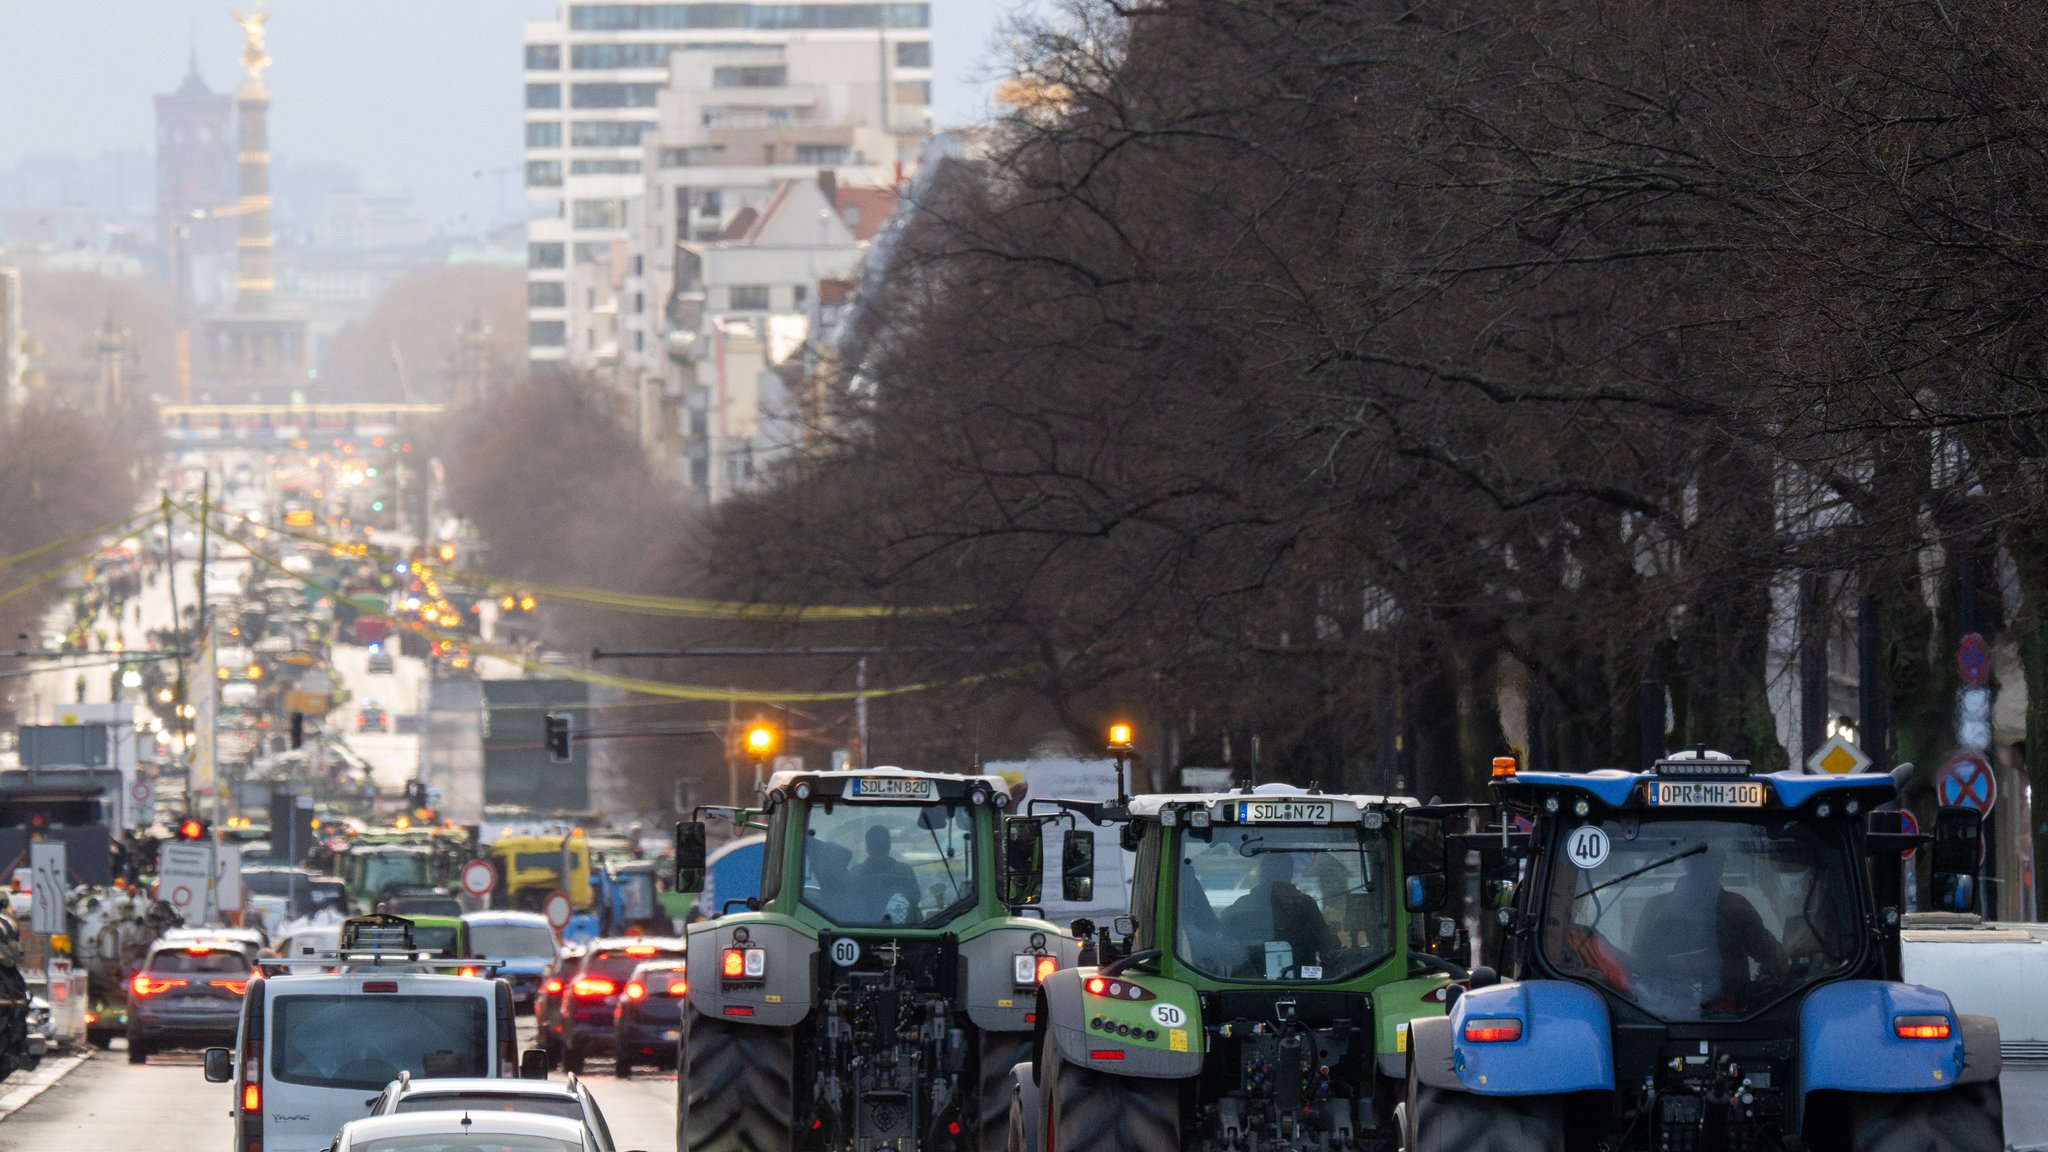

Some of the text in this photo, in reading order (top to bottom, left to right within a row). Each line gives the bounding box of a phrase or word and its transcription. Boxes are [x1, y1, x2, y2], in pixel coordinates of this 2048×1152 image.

[861, 780, 928, 794] SDL N 820
[1661, 785, 1692, 804] OPR
[1254, 804, 1283, 820] SDL
[1293, 804, 1304, 819] N
[1306, 804, 1325, 820] 72
[1575, 834, 1601, 860] 40
[836, 943, 854, 961] 60
[1158, 1006, 1179, 1024] 50
